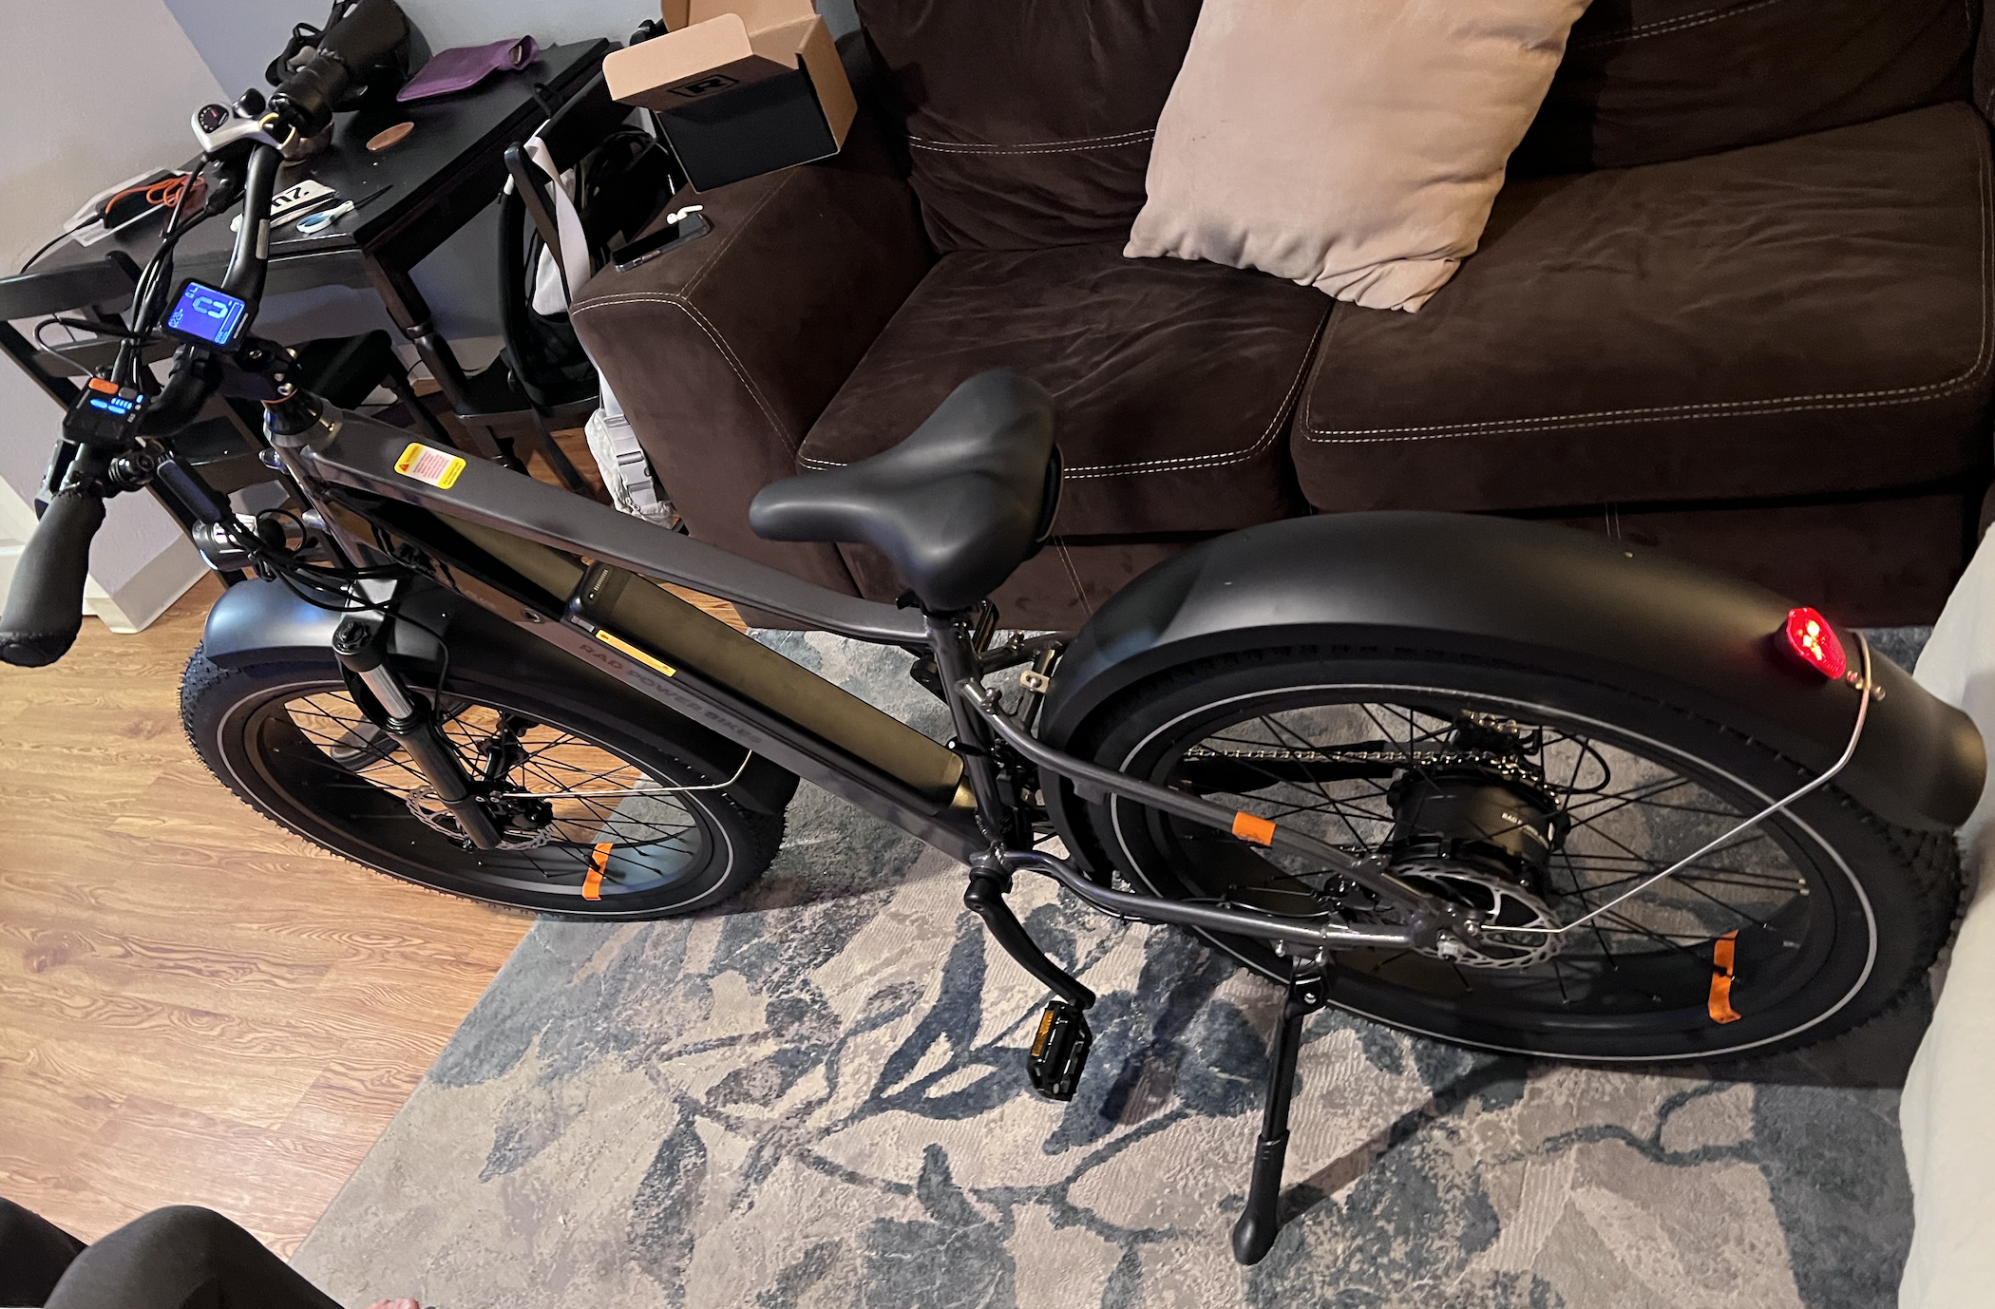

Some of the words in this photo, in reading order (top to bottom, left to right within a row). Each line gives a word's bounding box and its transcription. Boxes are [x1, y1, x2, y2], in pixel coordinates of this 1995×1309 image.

[579, 644, 623, 669] RAD
[628, 670, 703, 711] POWER
[704, 711, 763, 743] BIKES
